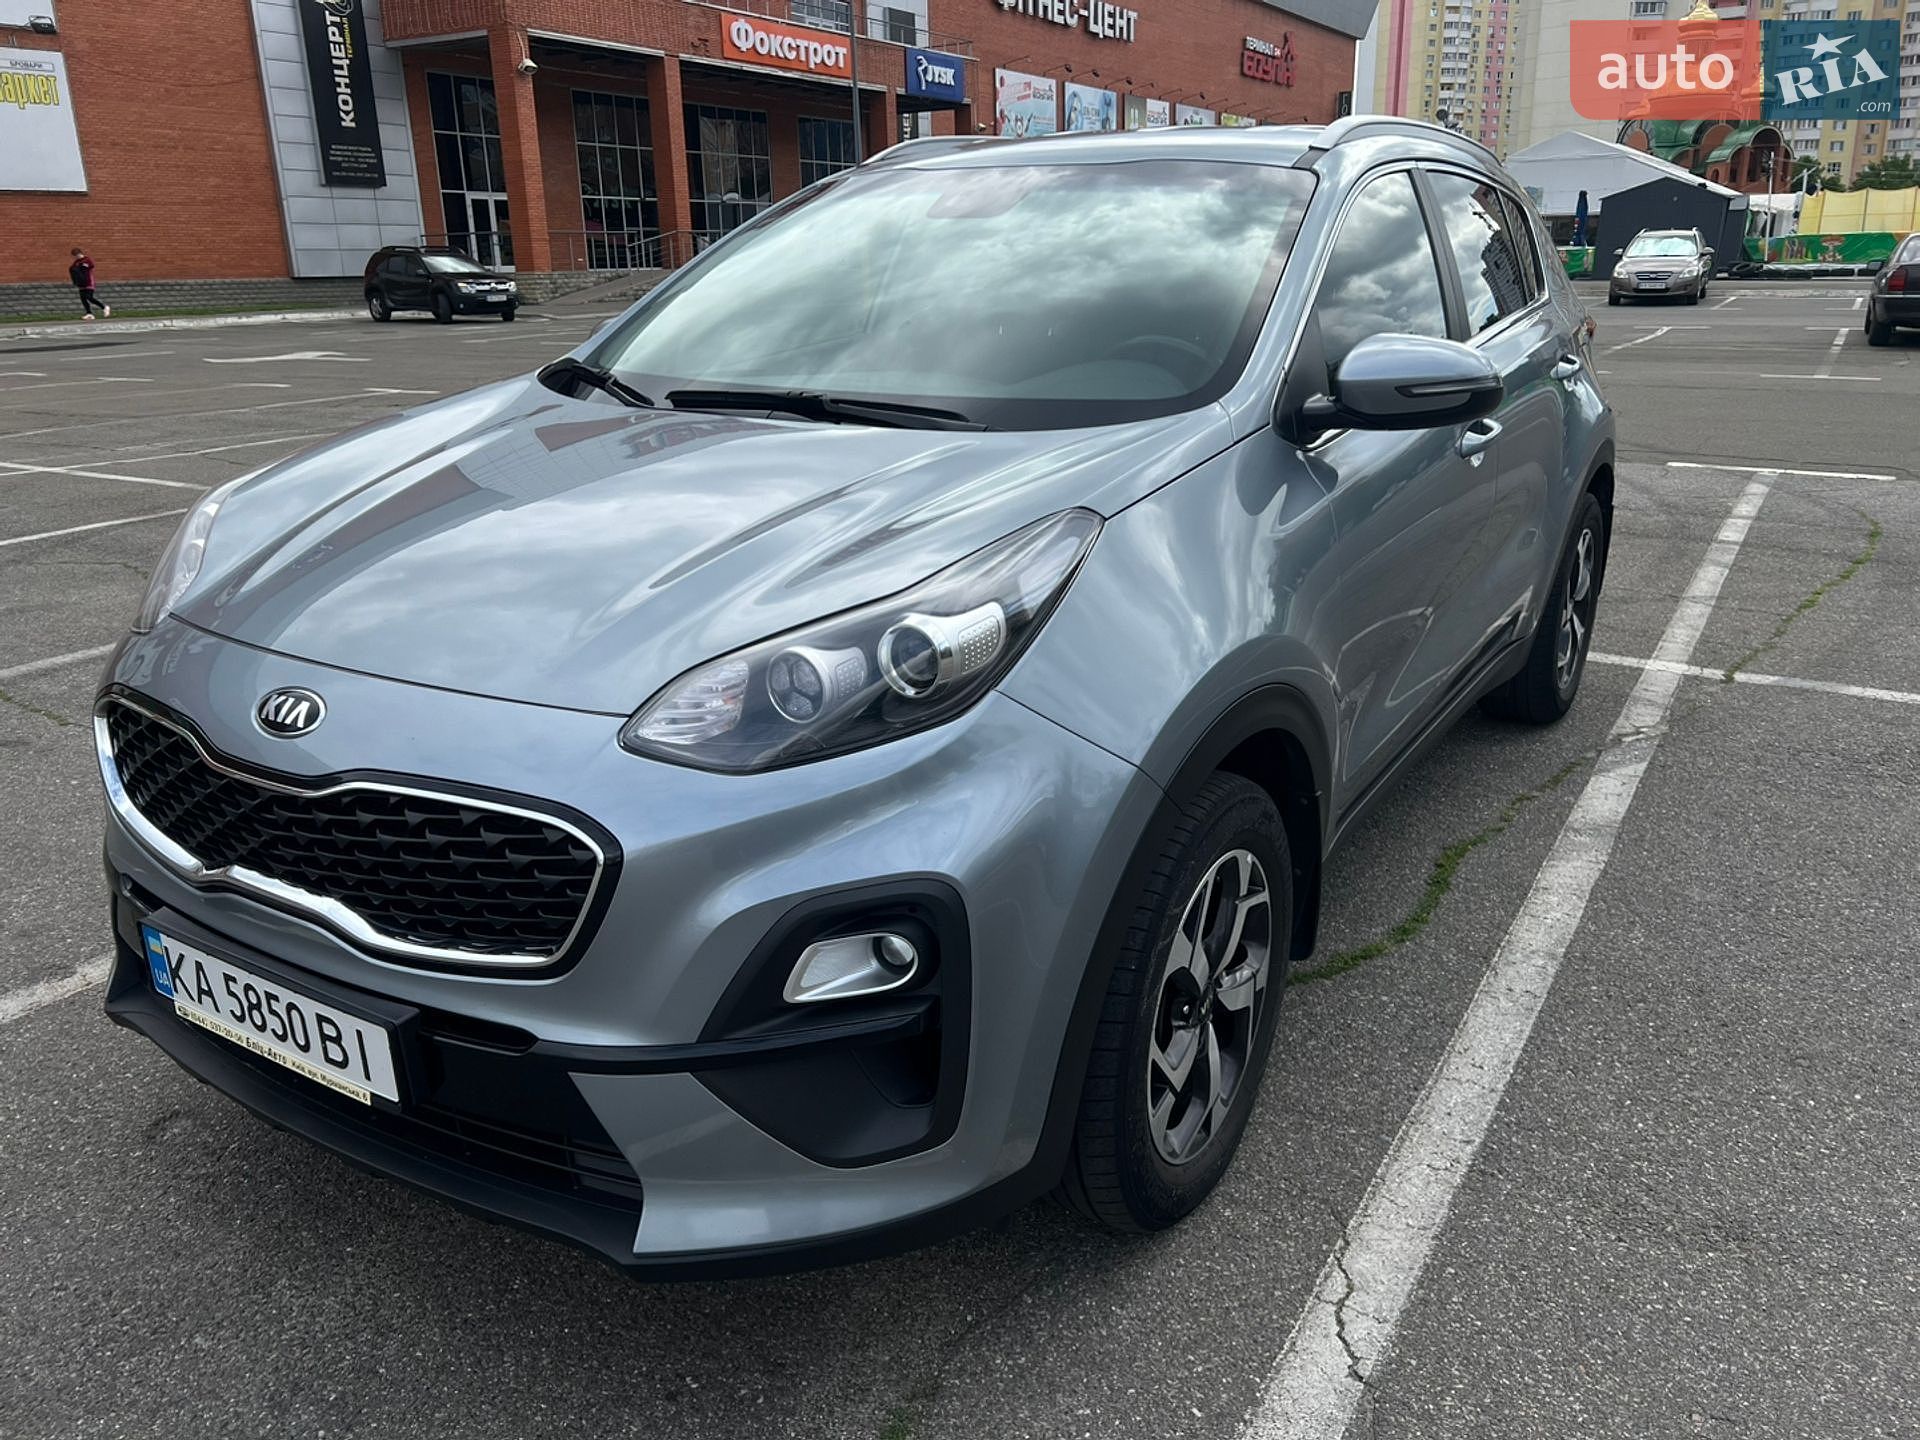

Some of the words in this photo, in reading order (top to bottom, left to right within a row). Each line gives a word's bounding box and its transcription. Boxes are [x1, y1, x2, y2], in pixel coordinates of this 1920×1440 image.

[730, 18, 847, 70] Фокстрот
[0, 70, 60, 110] аркет
[325, 10, 356, 128] КОНЦЕРТ
[925, 65, 955, 87] JYSK
[261, 694, 310, 728] KIA
[163, 945, 220, 1014] KA
[222, 971, 311, 1053] 5850
[315, 1012, 371, 1082] BI
